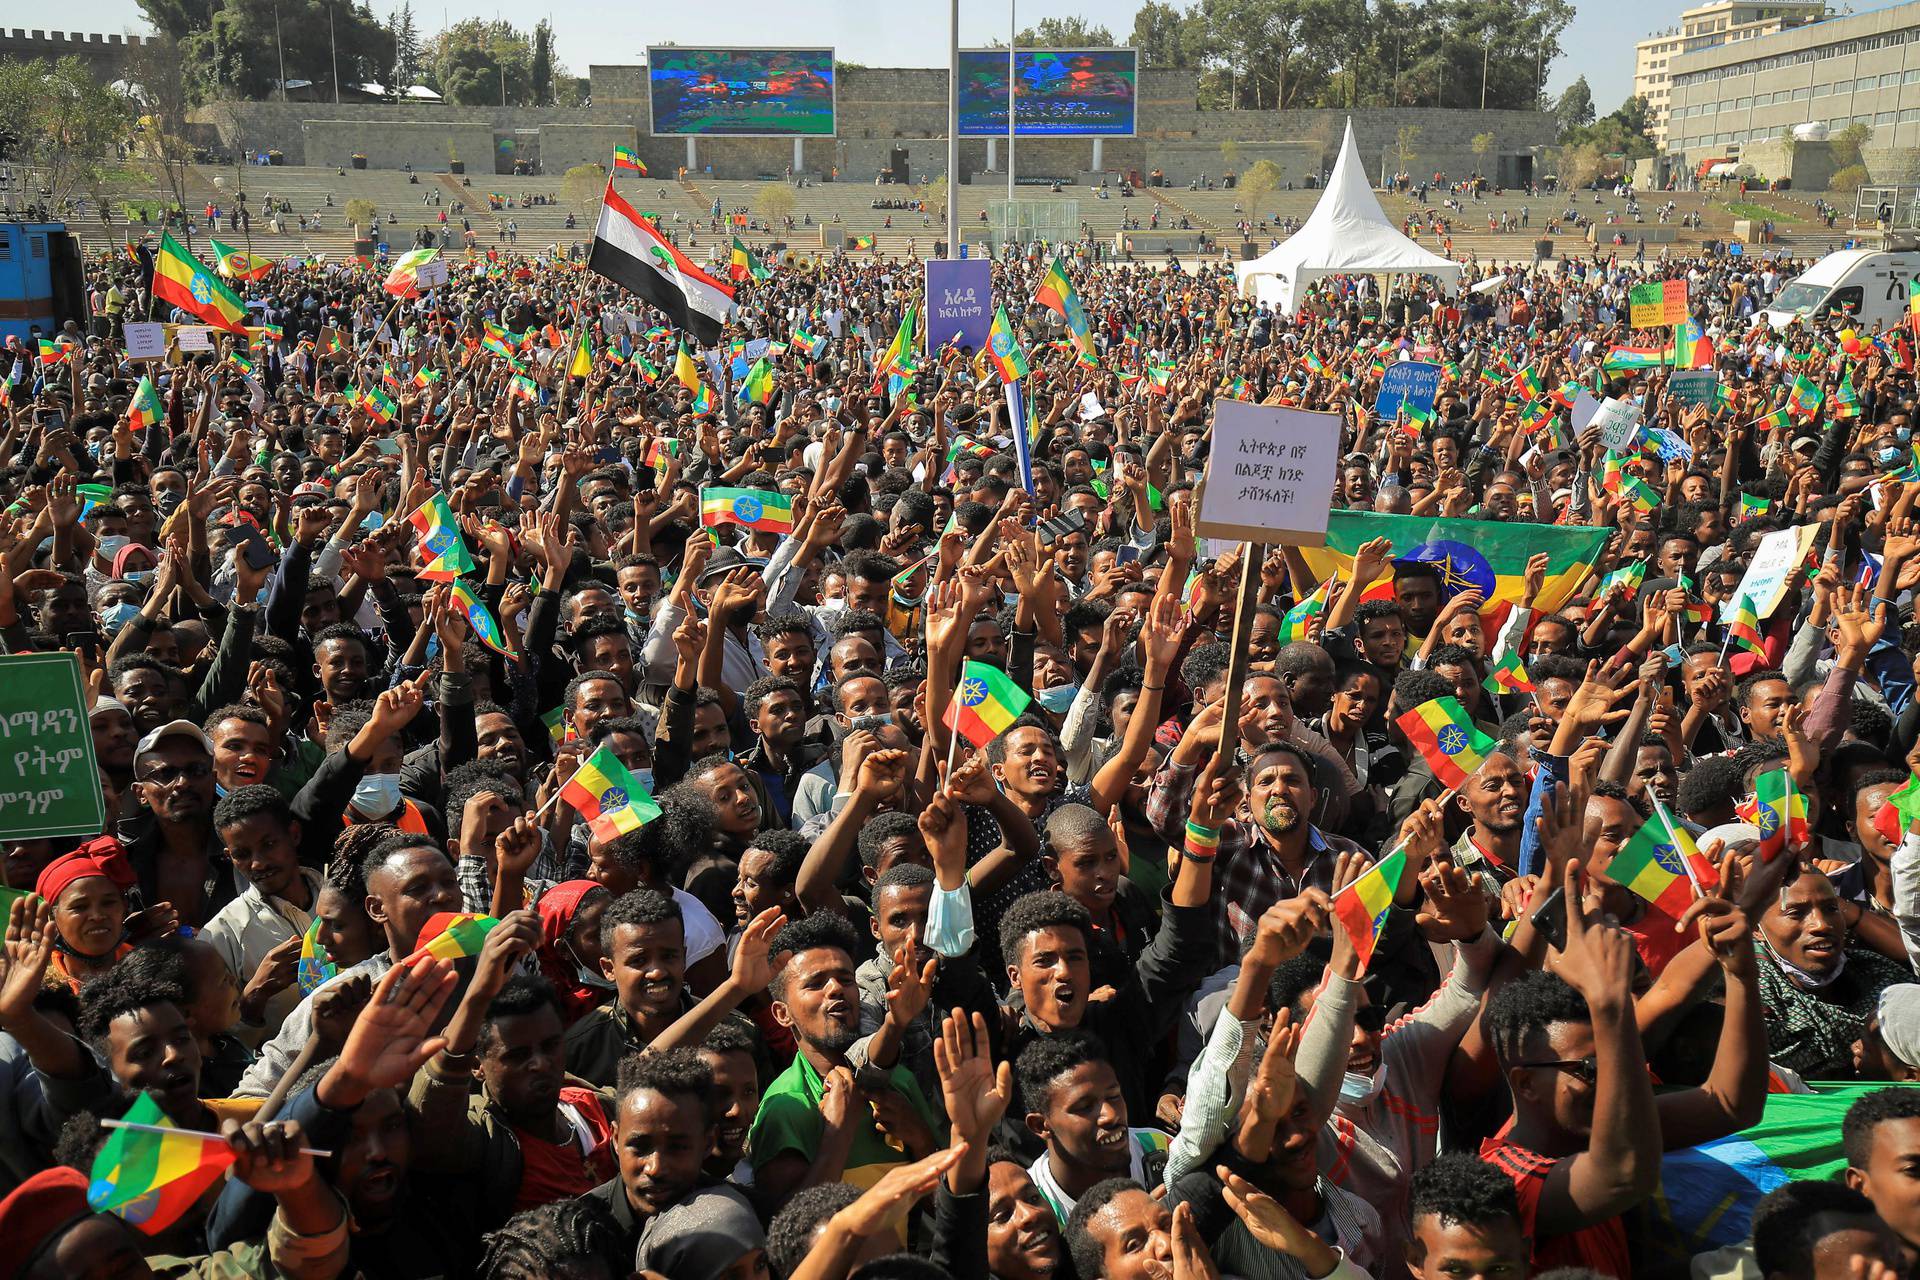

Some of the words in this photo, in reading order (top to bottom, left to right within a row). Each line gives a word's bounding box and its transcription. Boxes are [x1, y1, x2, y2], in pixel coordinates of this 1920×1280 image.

[945, 288, 976, 305] አራዳ
[1239, 438, 1286, 457] ኢትዮጵያ
[14, 745, 84, 777] የትም
